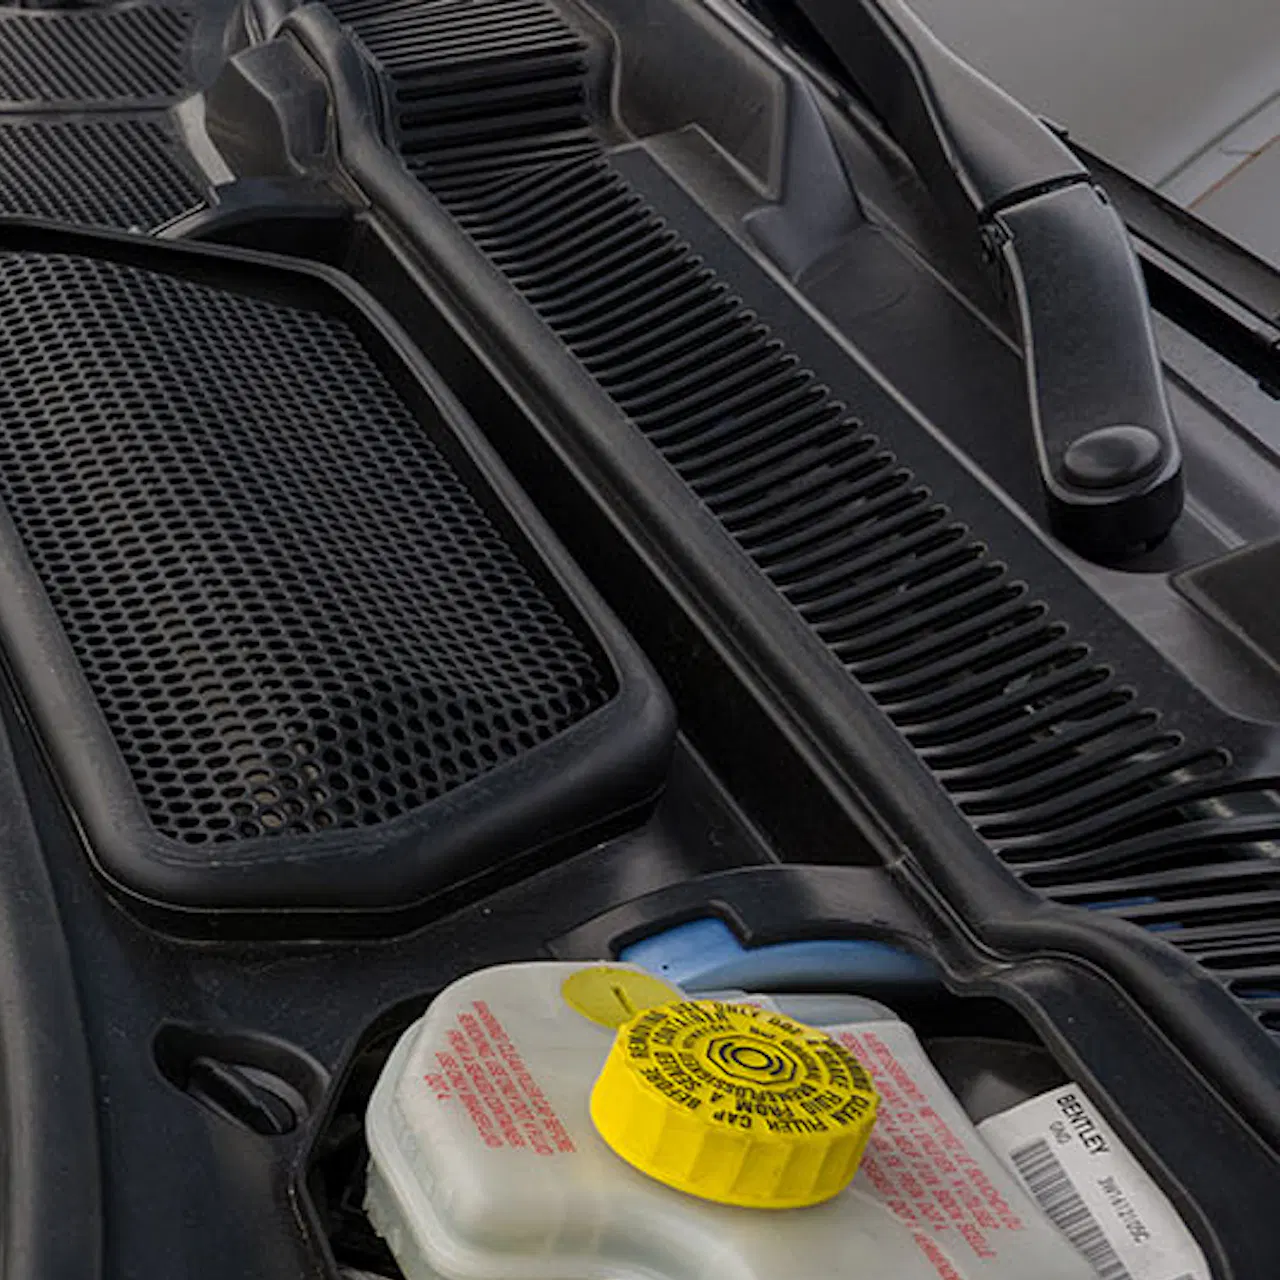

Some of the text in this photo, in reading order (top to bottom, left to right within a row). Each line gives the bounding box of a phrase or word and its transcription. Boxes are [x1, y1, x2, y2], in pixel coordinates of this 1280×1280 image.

[636, 1067, 702, 1111] BEFORE
[711, 1108, 751, 1130] CAP
[734, 1098, 798, 1119] FROM
[1056, 1094, 1111, 1155] BENTLEY
